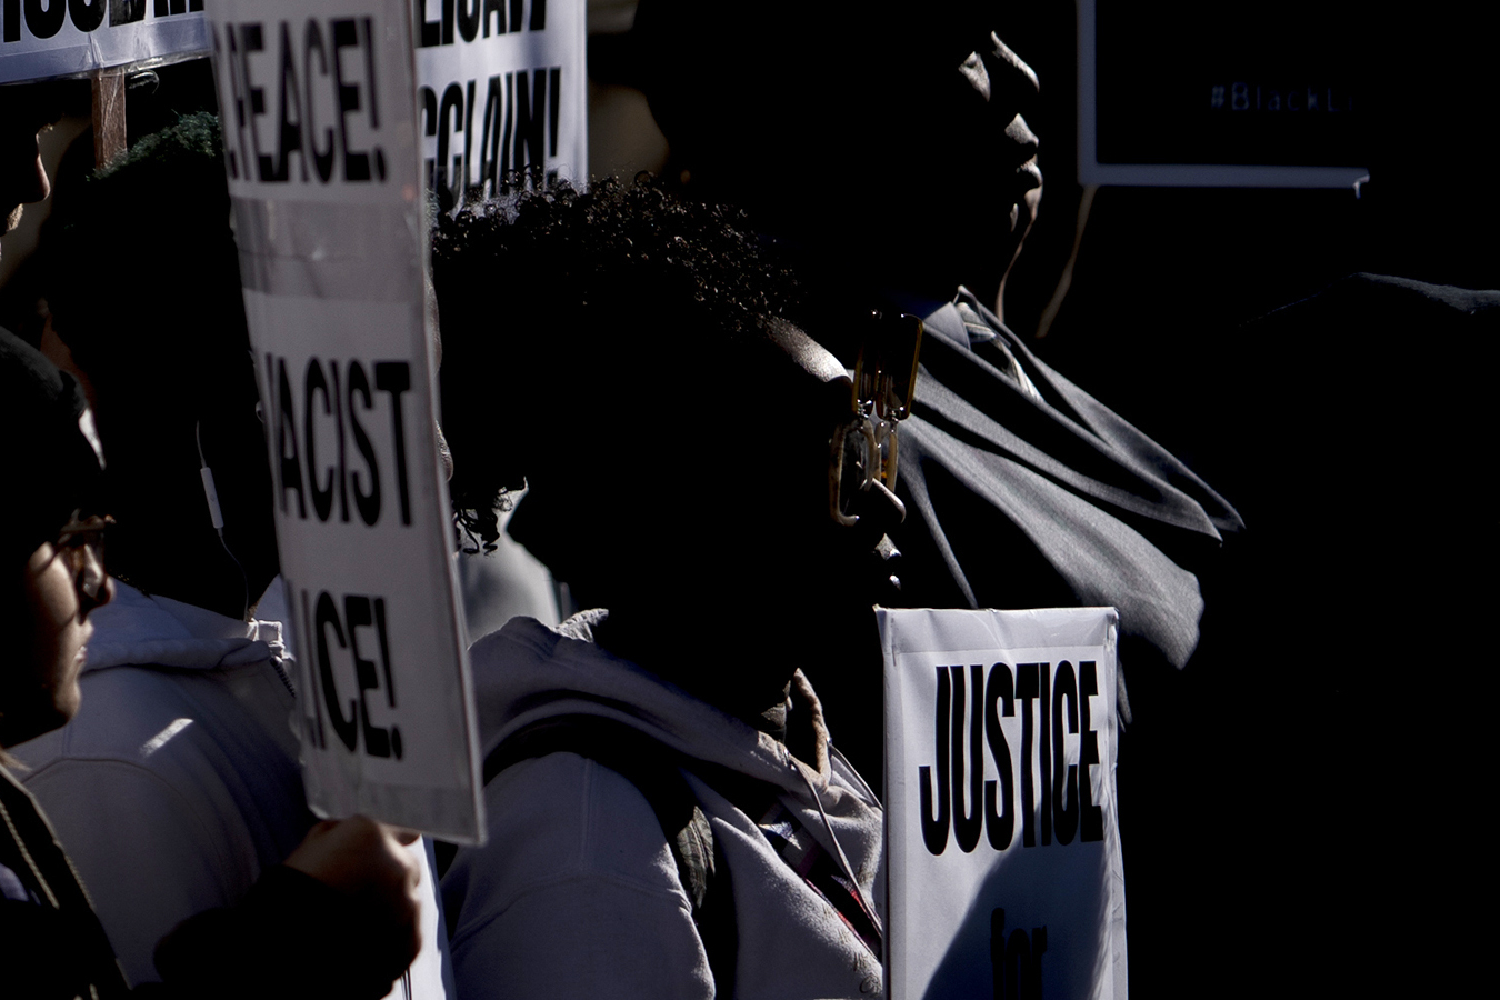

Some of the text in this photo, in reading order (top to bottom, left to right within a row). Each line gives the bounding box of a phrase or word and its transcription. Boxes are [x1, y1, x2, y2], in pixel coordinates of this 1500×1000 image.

[418, 67, 561, 200] CCLAIN!
[268, 352, 412, 527] ACIST
[919, 660, 1104, 856] JUSTICE
[990, 907, 1049, 1000] for
